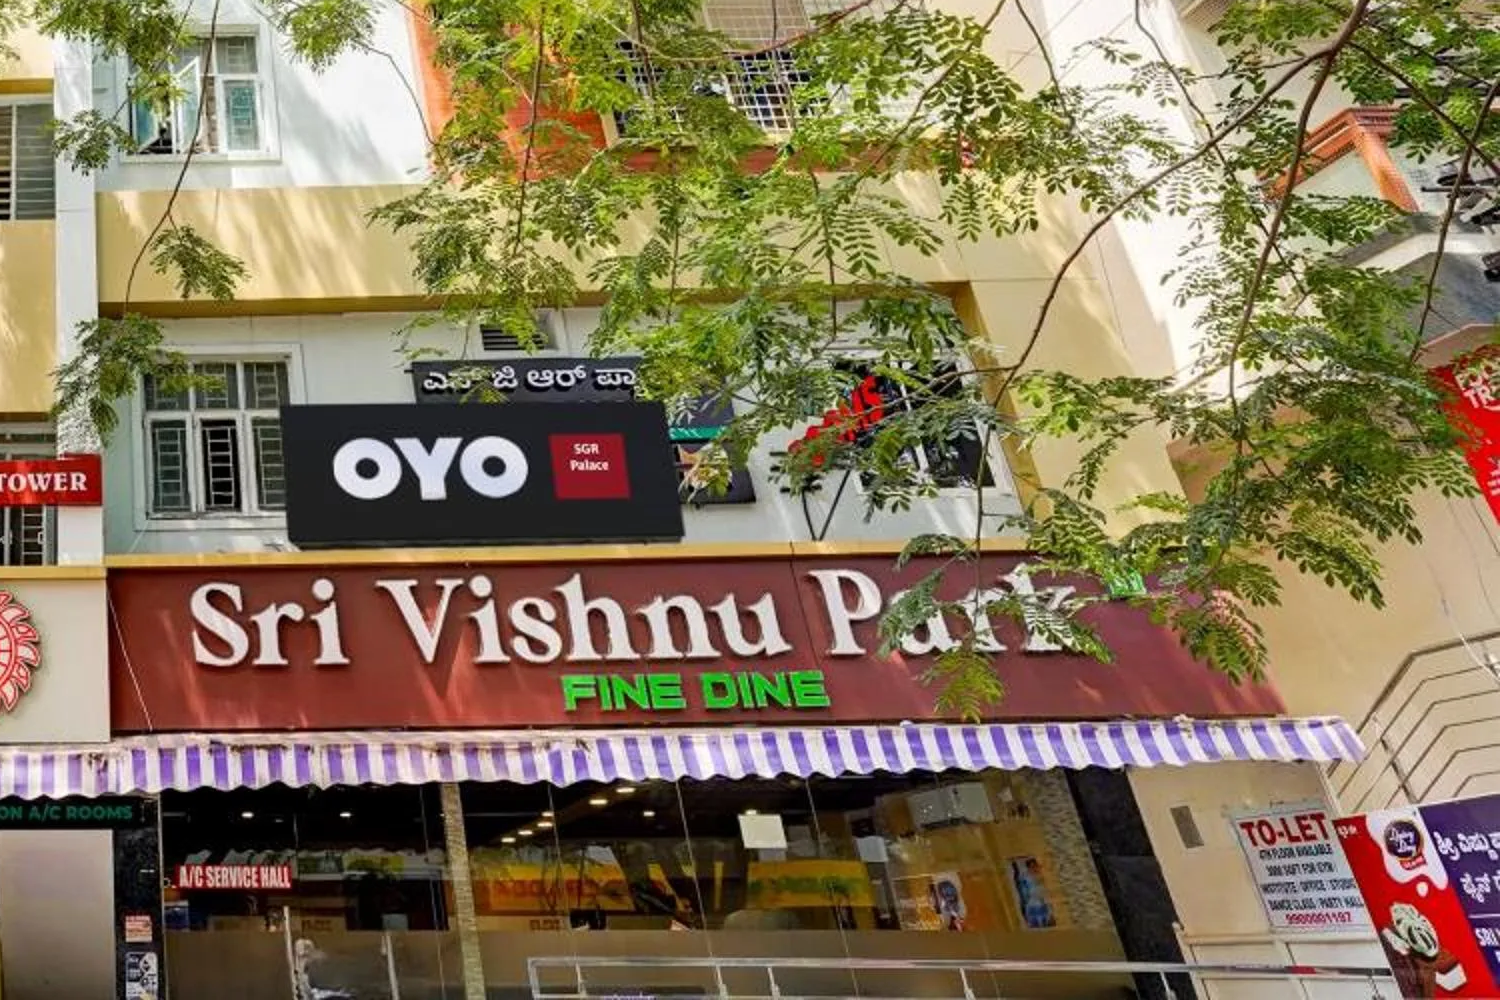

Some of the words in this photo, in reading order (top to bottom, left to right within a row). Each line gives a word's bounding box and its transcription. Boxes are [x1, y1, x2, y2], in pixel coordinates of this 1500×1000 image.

[573, 443, 599, 455] SGR
[333, 436, 528, 500] OYO
[570, 459, 609, 471] Palace
[190, 578, 350, 667] Sri
[375, 572, 793, 663] Vishnu
[561, 673, 687, 711] FINE
[703, 670, 831, 708] DINE
[29, 804, 60, 820] A/C
[67, 804, 133, 820] ROOMS
[1239, 812, 1330, 847] TO-LET
[180, 866, 202, 887] A/C
[206, 865, 258, 887] SERVICE
[261, 864, 291, 887] HALL
